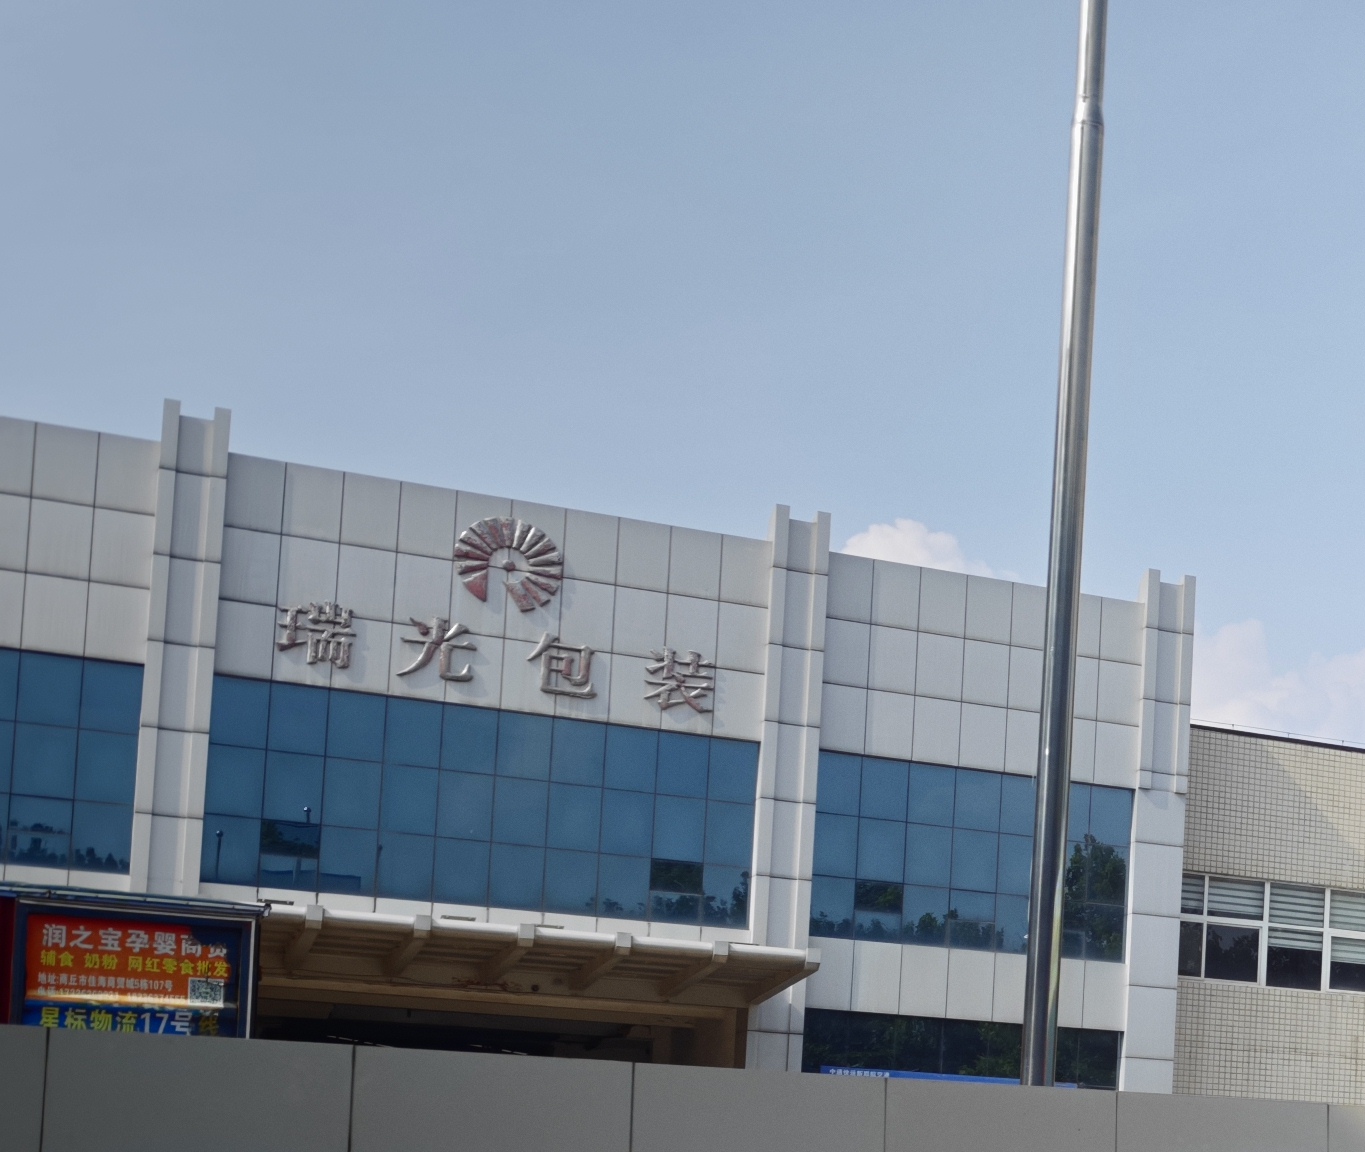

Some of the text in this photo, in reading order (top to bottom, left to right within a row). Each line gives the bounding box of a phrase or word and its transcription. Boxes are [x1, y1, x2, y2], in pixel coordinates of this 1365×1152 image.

[277, 600, 715, 713] 瑞光包装
[84, 953, 118, 971] 奶粉
